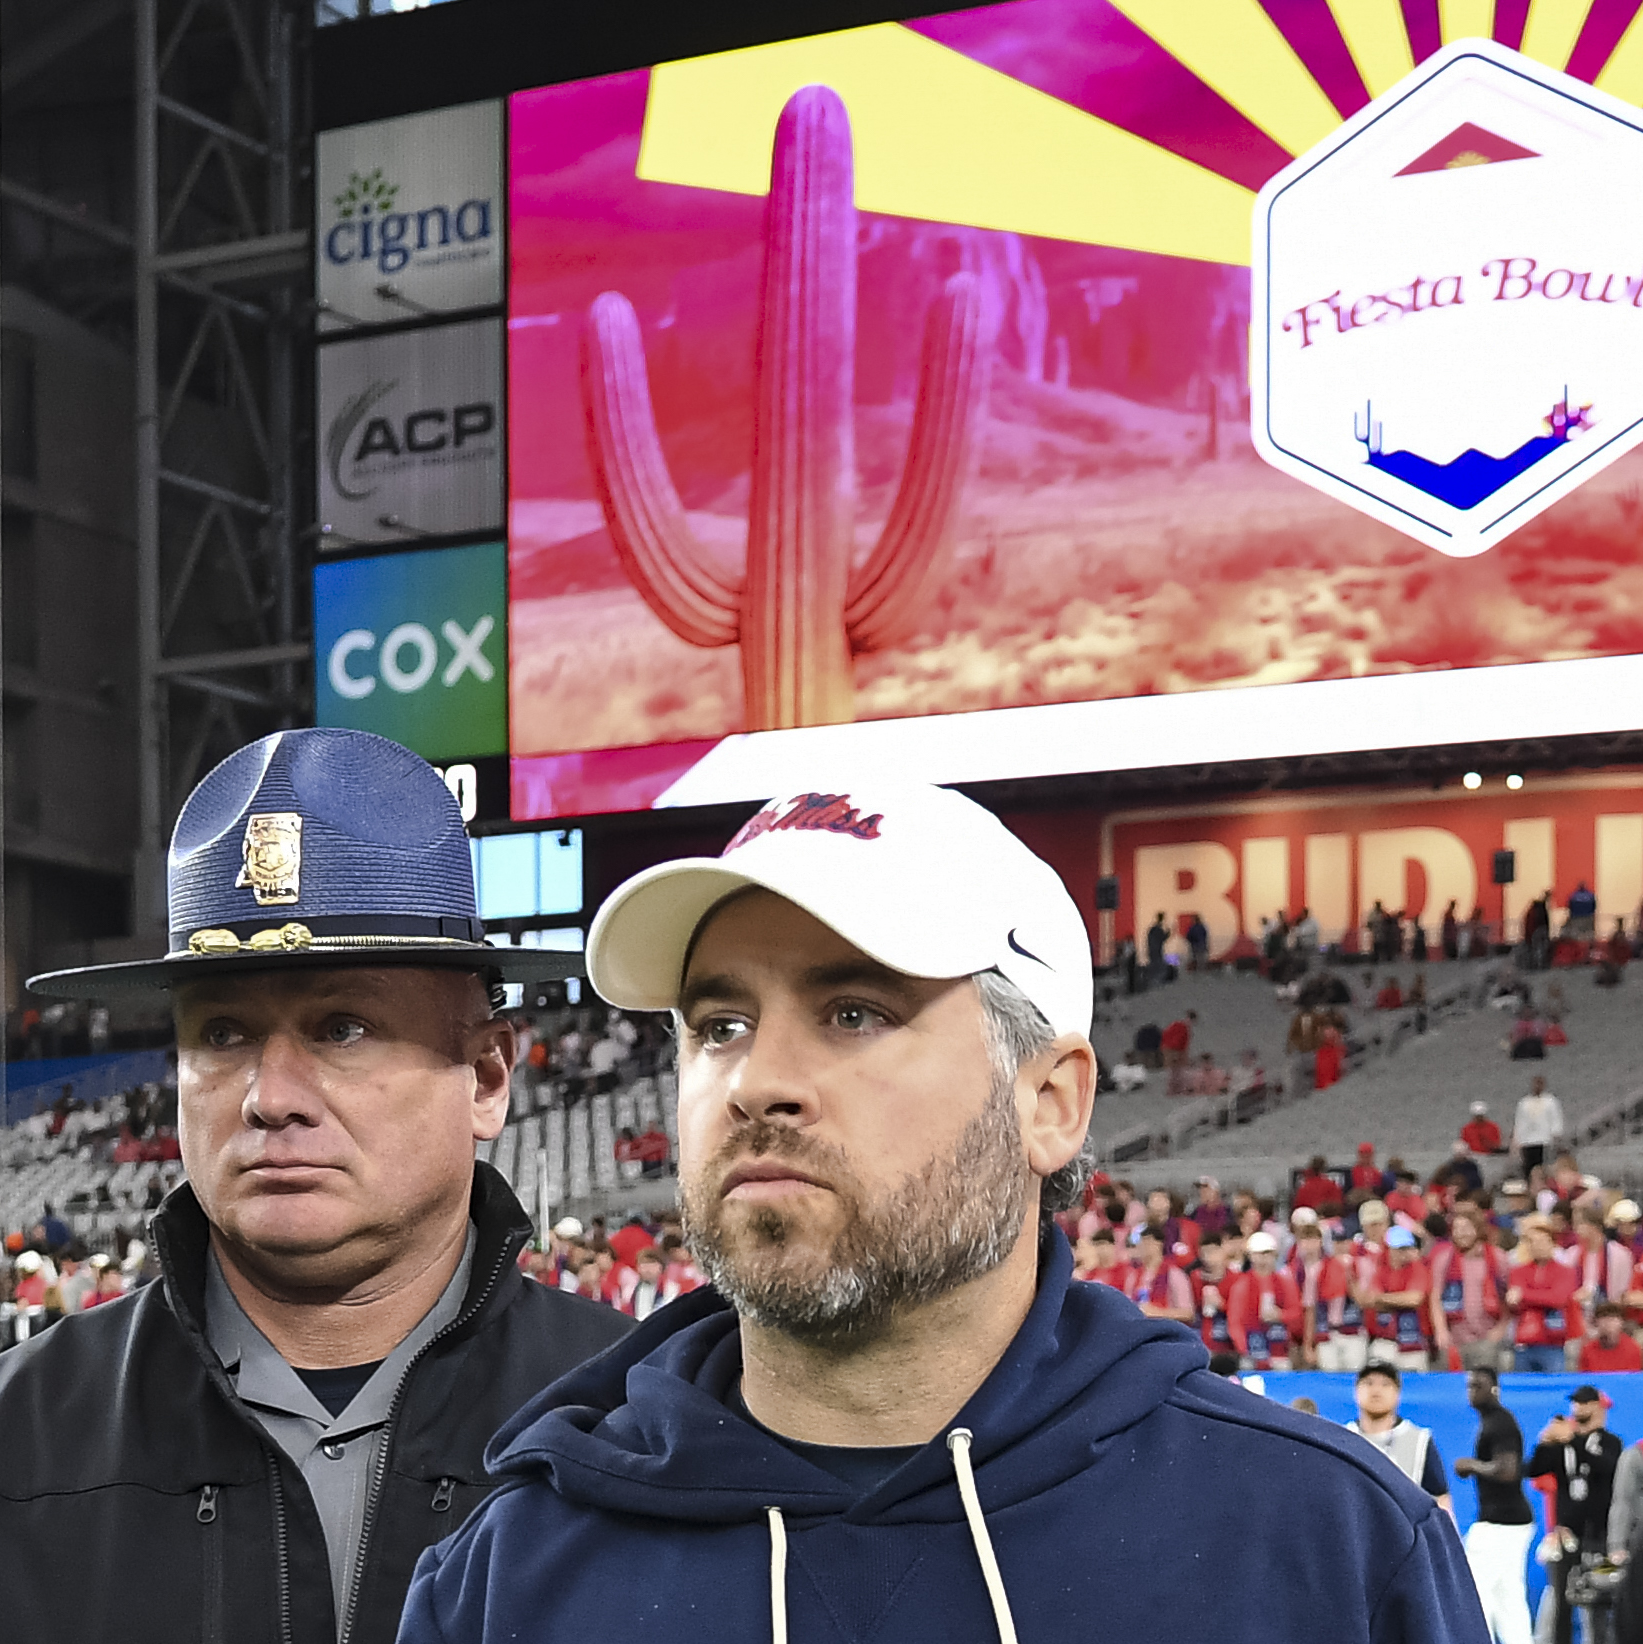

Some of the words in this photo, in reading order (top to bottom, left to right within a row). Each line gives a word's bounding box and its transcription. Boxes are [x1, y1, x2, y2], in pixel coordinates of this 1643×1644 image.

[326, 198, 492, 274] cigna
[1282, 276, 1465, 349] Fiesta
[354, 402, 495, 464] ACP
[327, 614, 496, 699] COX
[1134, 825, 1477, 964] BUD
